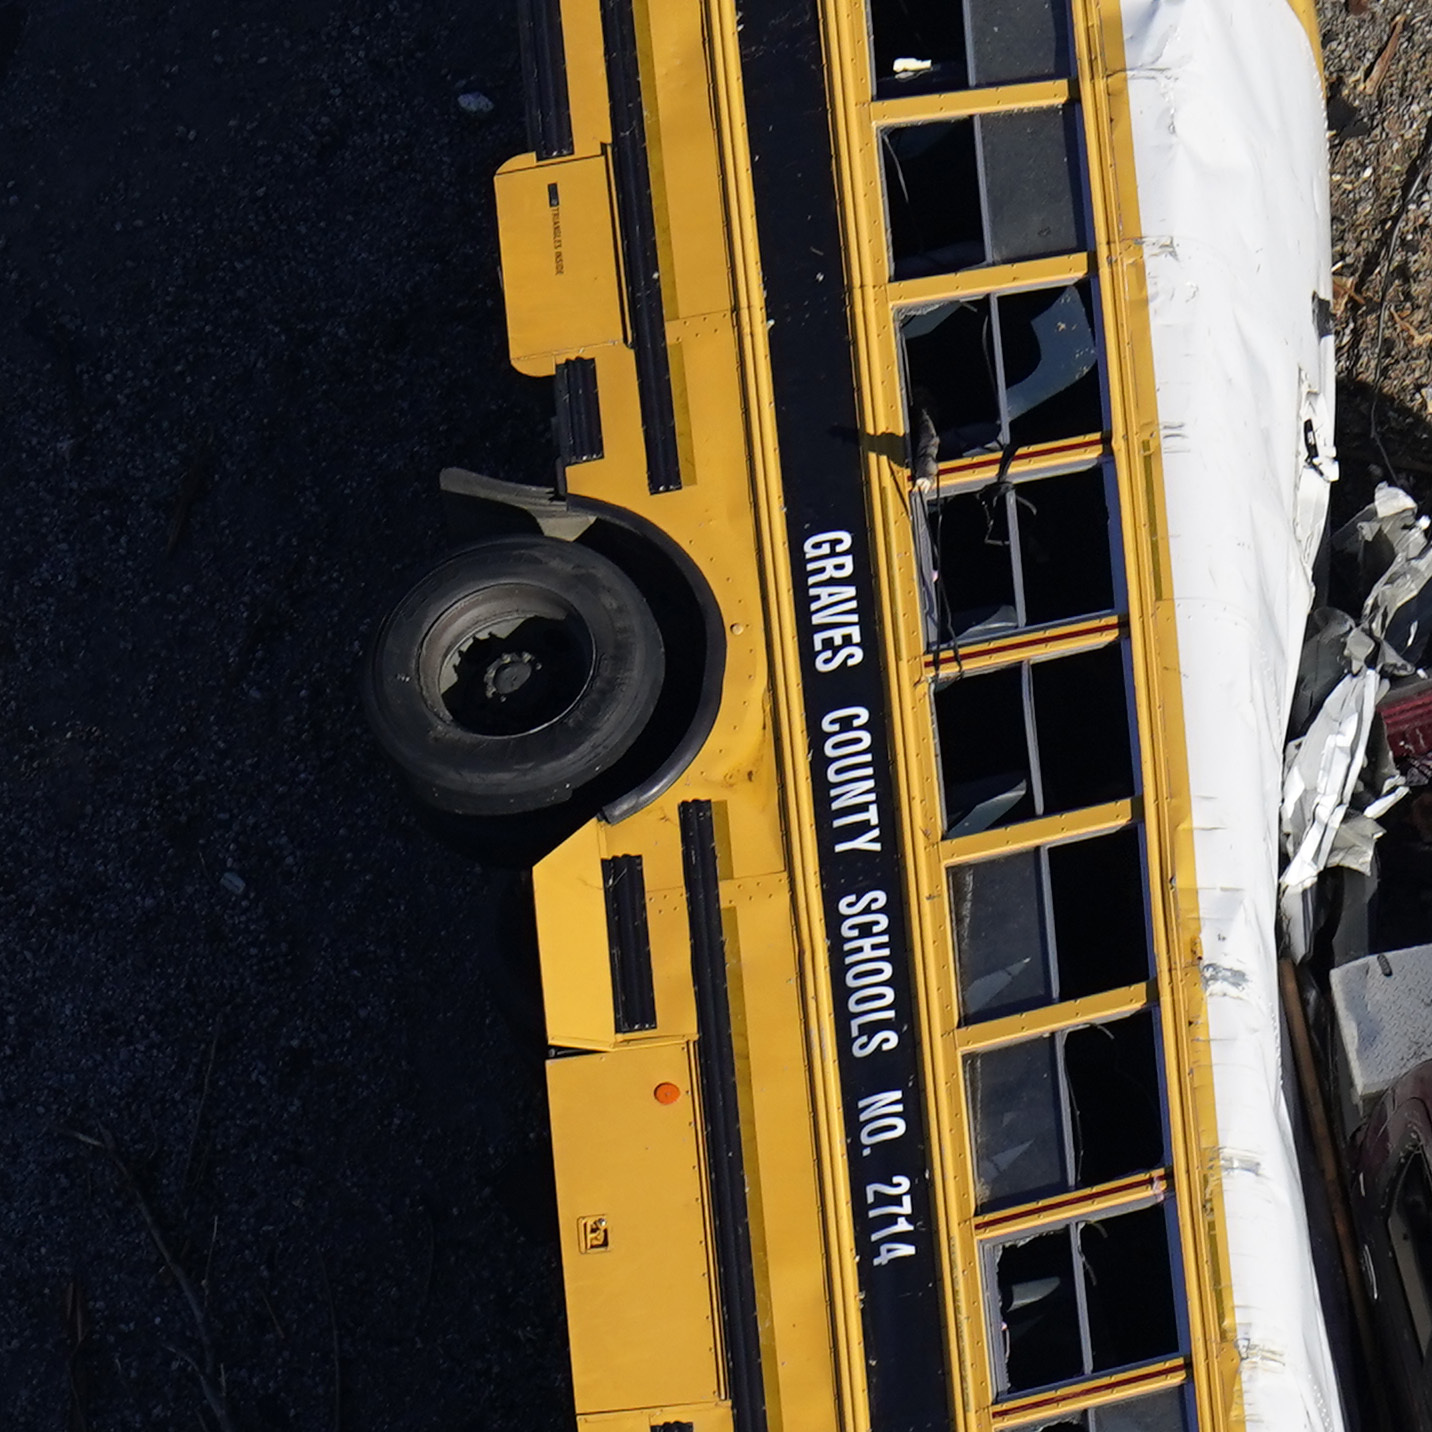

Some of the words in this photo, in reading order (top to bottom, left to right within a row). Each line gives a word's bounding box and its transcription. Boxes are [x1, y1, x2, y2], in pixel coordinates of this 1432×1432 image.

[551, 207, 562, 249] TRIANGLES
[554, 252, 564, 275] INSIDE
[804, 530, 863, 672] GRAVES
[821, 706, 881, 853] COUNTY
[837, 890, 899, 1058] SCHOOLS
[858, 1090, 906, 1156] NO.
[866, 1176, 916, 1266] 2714
